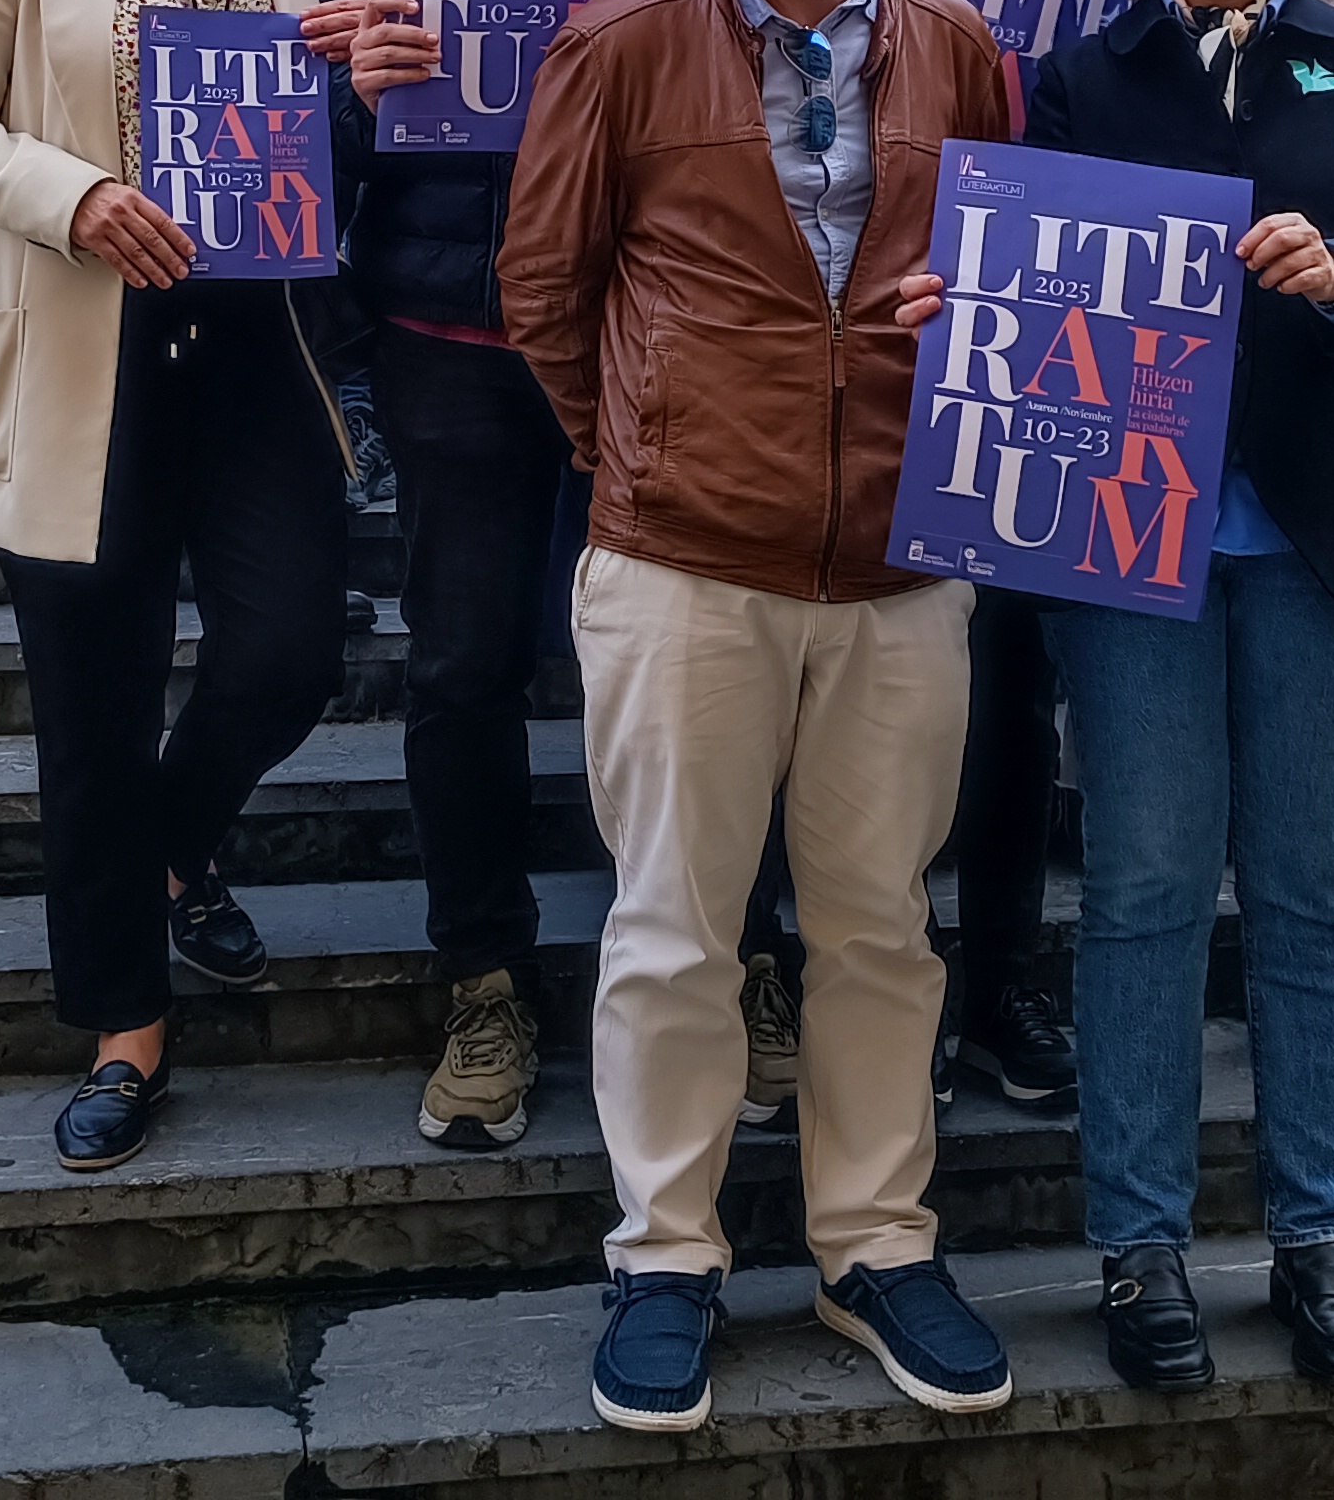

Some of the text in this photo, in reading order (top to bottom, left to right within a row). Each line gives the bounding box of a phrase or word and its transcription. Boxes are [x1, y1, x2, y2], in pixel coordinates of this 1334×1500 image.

[477, 3, 557, 29] 10-23
[986, 25, 1027, 48] 025
[149, 40, 318, 107] LITE
[203, 87, 238, 100] 2025
[209, 171, 263, 190] 10-23
[961, 179, 1021, 197] LITERAKTUM
[153, 167, 324, 259] TUM
[946, 205, 1228, 320] LITE
[1035, 275, 1091, 303] 2025
[1132, 366, 1193, 394] Hitzen
[1026, 400, 1058, 414] Azaroa
[1129, 384, 1173, 411] hiria
[1126, 417, 1185, 438] las palabras
[1127, 407, 1190, 427] La ciudad de
[1022, 417, 1111, 458] 10-23
[930, 394, 1198, 588] TUM
